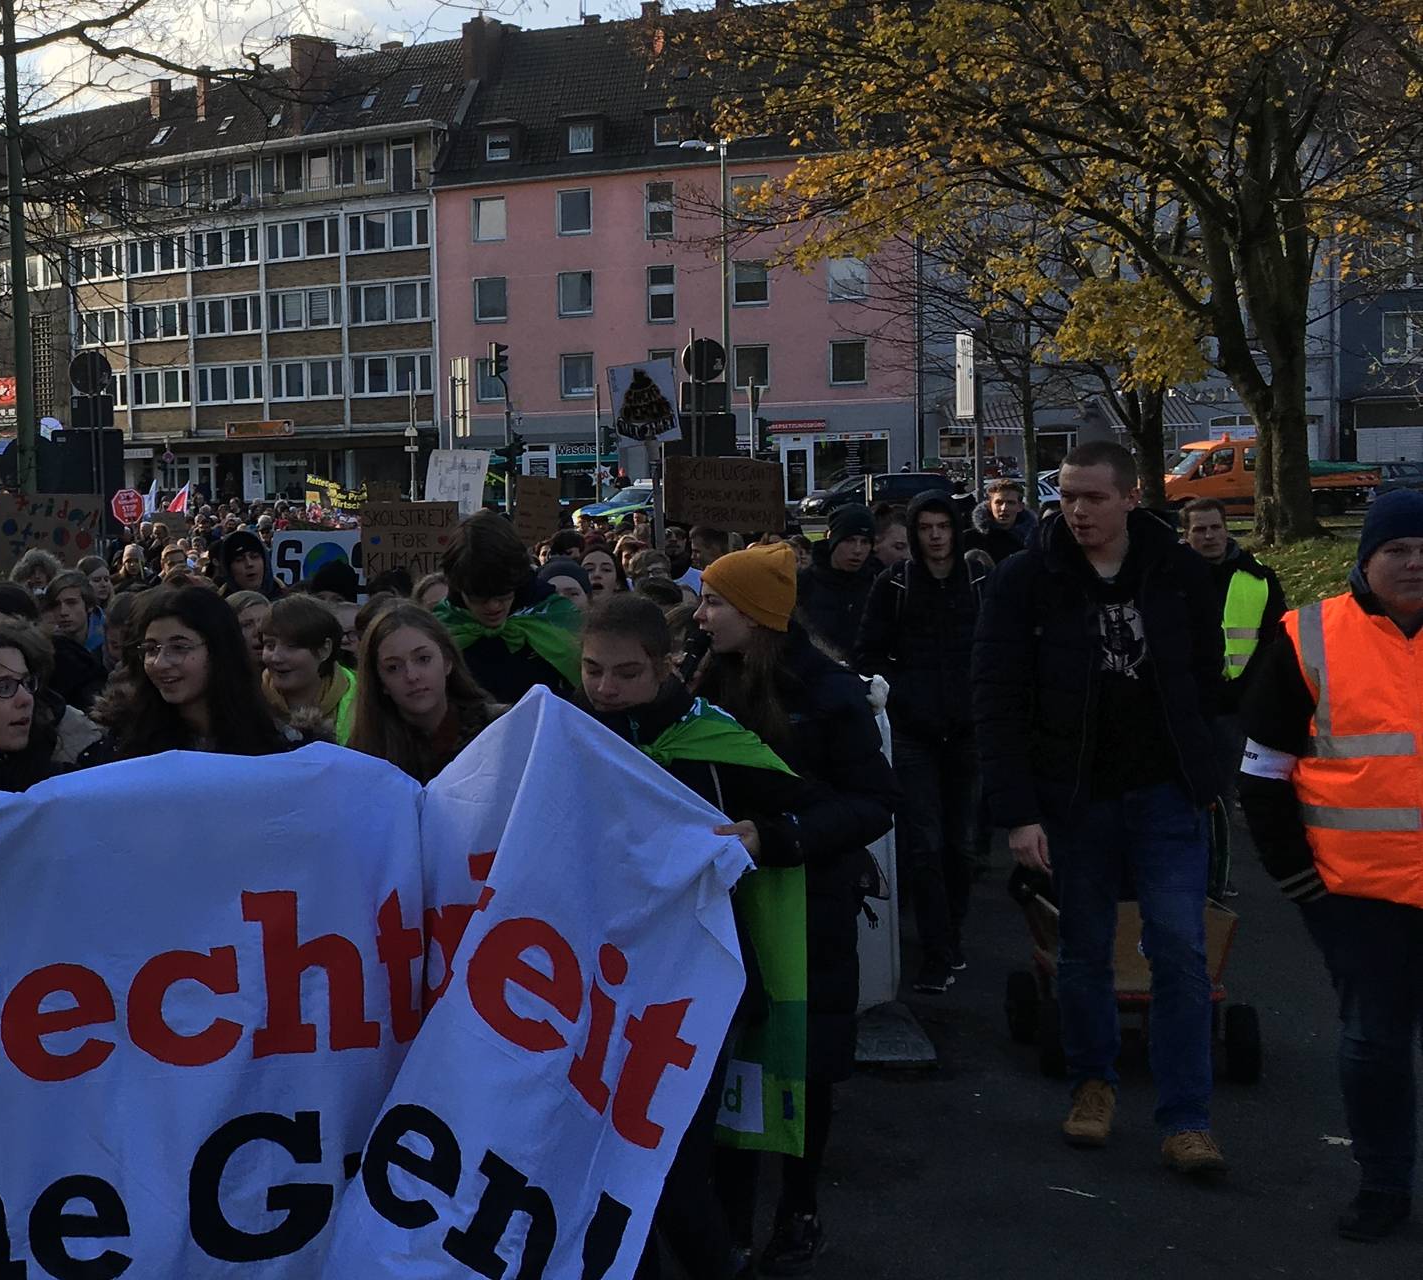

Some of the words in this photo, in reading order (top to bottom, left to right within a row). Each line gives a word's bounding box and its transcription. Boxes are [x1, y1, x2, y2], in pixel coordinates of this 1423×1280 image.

[556, 443, 597, 456] Waschs
[362, 508, 455, 528] SKOLSTREJK
[366, 552, 444, 576] KLIMATE
